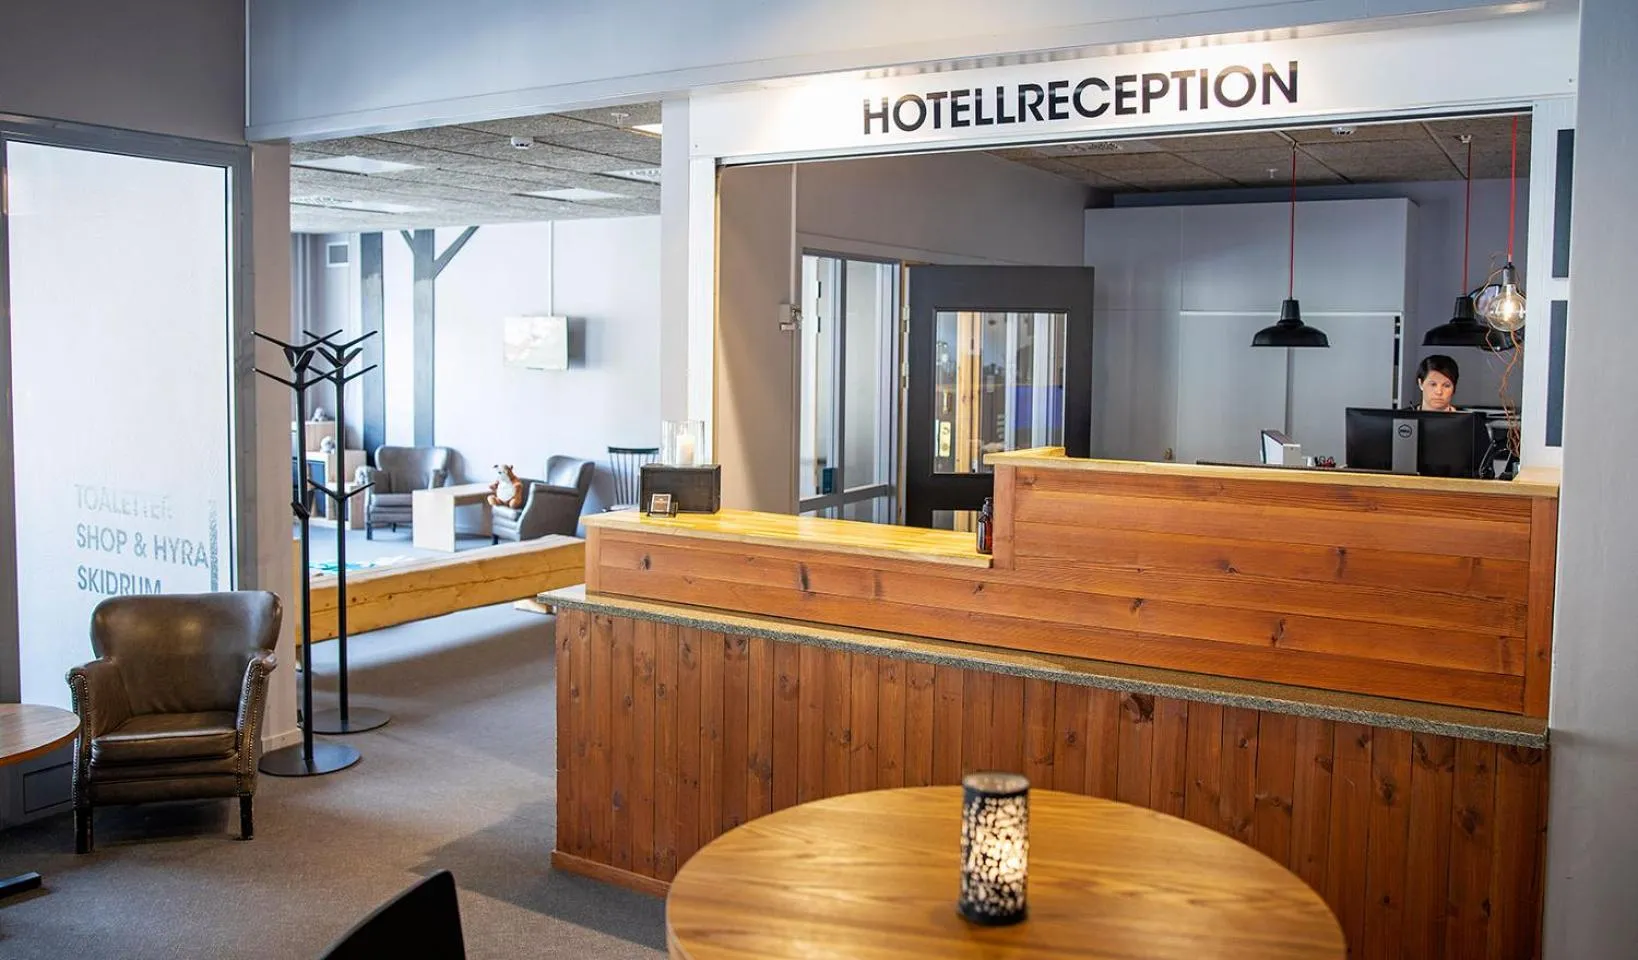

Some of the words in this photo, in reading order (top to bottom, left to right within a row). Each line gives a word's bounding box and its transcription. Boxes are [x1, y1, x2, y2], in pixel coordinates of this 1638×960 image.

[863, 61, 1298, 134] HOTELLRECEPTION
[77, 523, 128, 554] SHOP
[134, 531, 147, 558] &
[154, 534, 208, 568] HYRA
